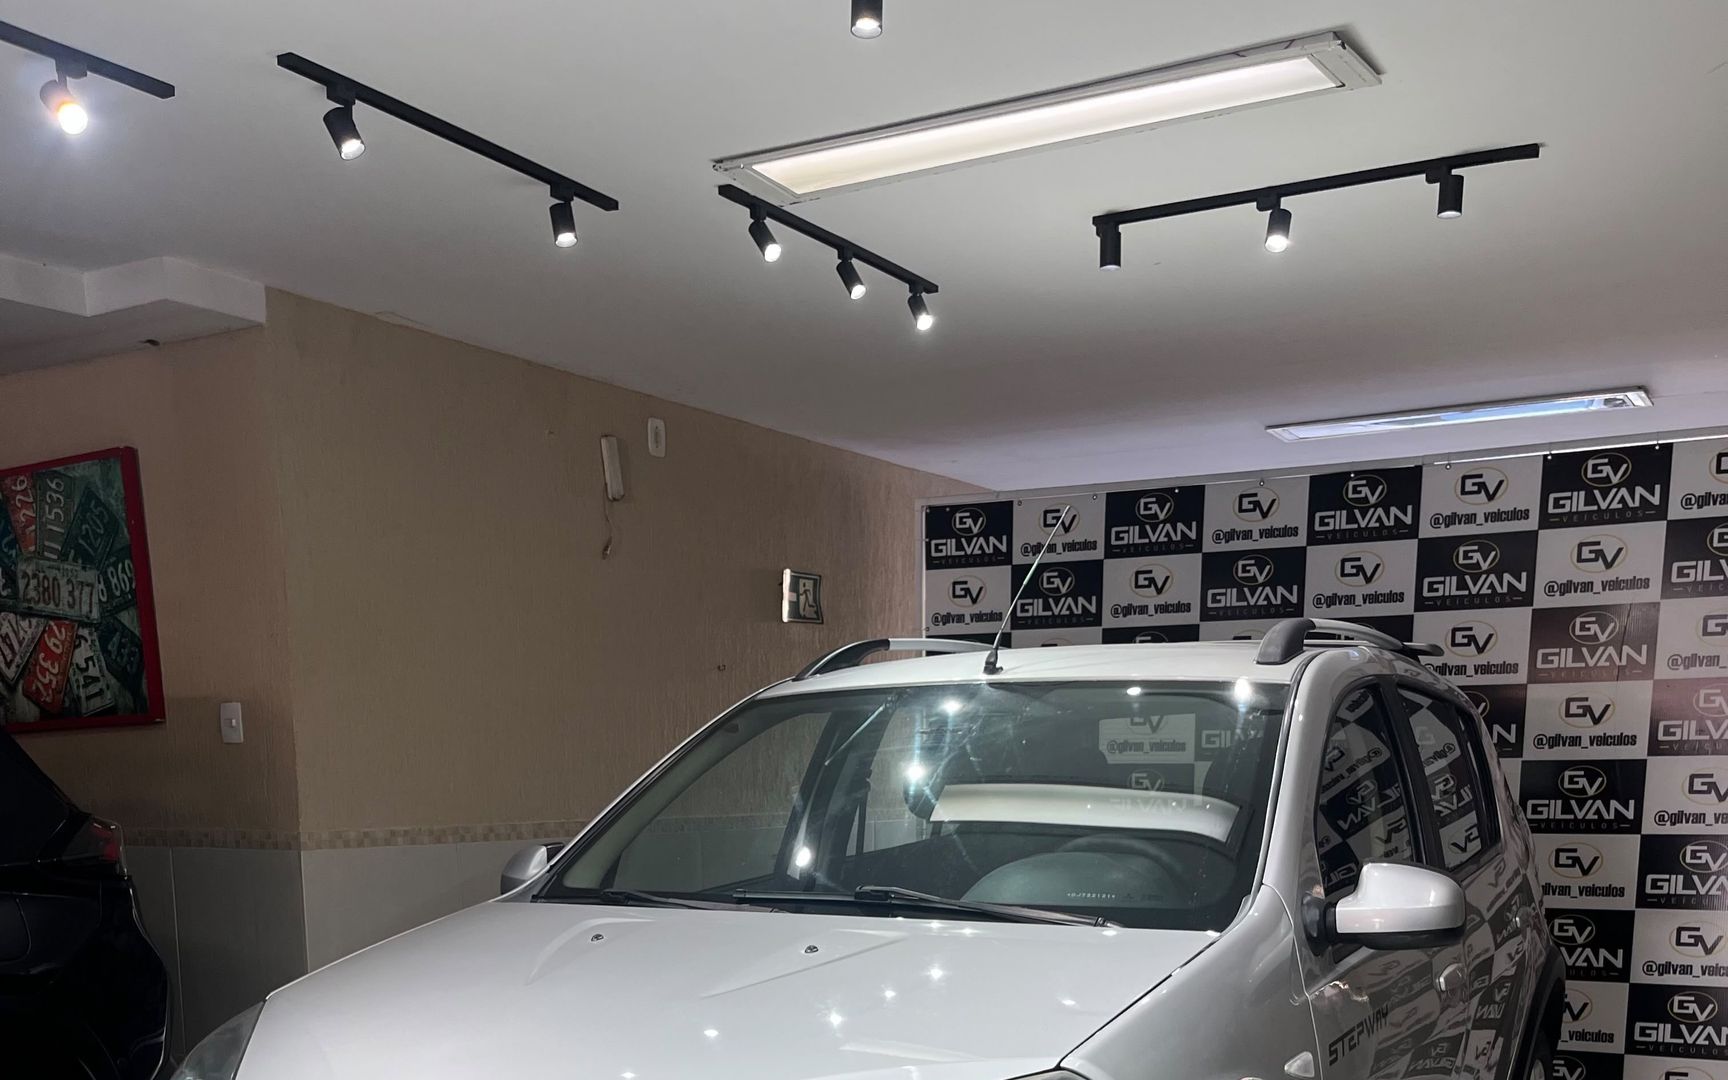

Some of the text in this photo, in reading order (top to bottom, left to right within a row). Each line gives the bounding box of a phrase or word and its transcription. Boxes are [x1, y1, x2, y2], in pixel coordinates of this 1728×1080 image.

[1586, 458, 1628, 484] GV
[1348, 480, 1383, 504] GV
[1460, 474, 1505, 502] GV
[1548, 484, 1661, 513] GILVAN
[1140, 497, 1171, 519] GV
[1238, 493, 1276, 519] GV
[1314, 504, 1413, 531] GILVAN
[1429, 507, 1530, 529] @gilvan_veiculos
[955, 511, 984, 534] GV
[1110, 521, 1197, 546] GILVAN
[1212, 525, 1299, 544] @gilvan_veiculos
[930, 535, 1007, 557] GILVAN
[1458, 545, 1496, 570] GV
[1577, 541, 1624, 570] GV
[1134, 570, 1170, 595] GV
[1237, 560, 1272, 582] GV
[1340, 557, 1381, 584] GV
[952, 581, 984, 605] GV
[1042, 572, 1072, 594] GV
[1422, 571, 1527, 597] GILVAN
[1544, 576, 1650, 597] @gilvan_veiculos
[1016, 596, 1097, 617] GILVAN
[1206, 585, 1298, 608] GILVAN
[1312, 590, 1404, 609] @gilvan_veiculos
[931, 610, 1003, 626] @gilvan_veiculos
[1110, 601, 1191, 618] @gilvan_veiculos
[1451, 627, 1494, 654] GV
[1575, 617, 1615, 640] GV
[1536, 644, 1648, 669] GILVAN
[1565, 697, 1611, 725] GV
[1533, 732, 1637, 749] @gilvan_veiculos
[1657, 720, 1728, 741] GILV
[1563, 770, 1603, 796] GV
[1526, 799, 1635, 820] GILVAN
[1654, 810, 1728, 827] @gilvan_ve
[1554, 848, 1600, 876] GV
[1686, 846, 1727, 872] GV
[1553, 919, 1593, 944] GV
[1675, 927, 1724, 956] GV
[1560, 946, 1623, 968] VAN
[1672, 995, 1714, 1021] GV
[1329, 1004, 1389, 1066] STEPWAY
